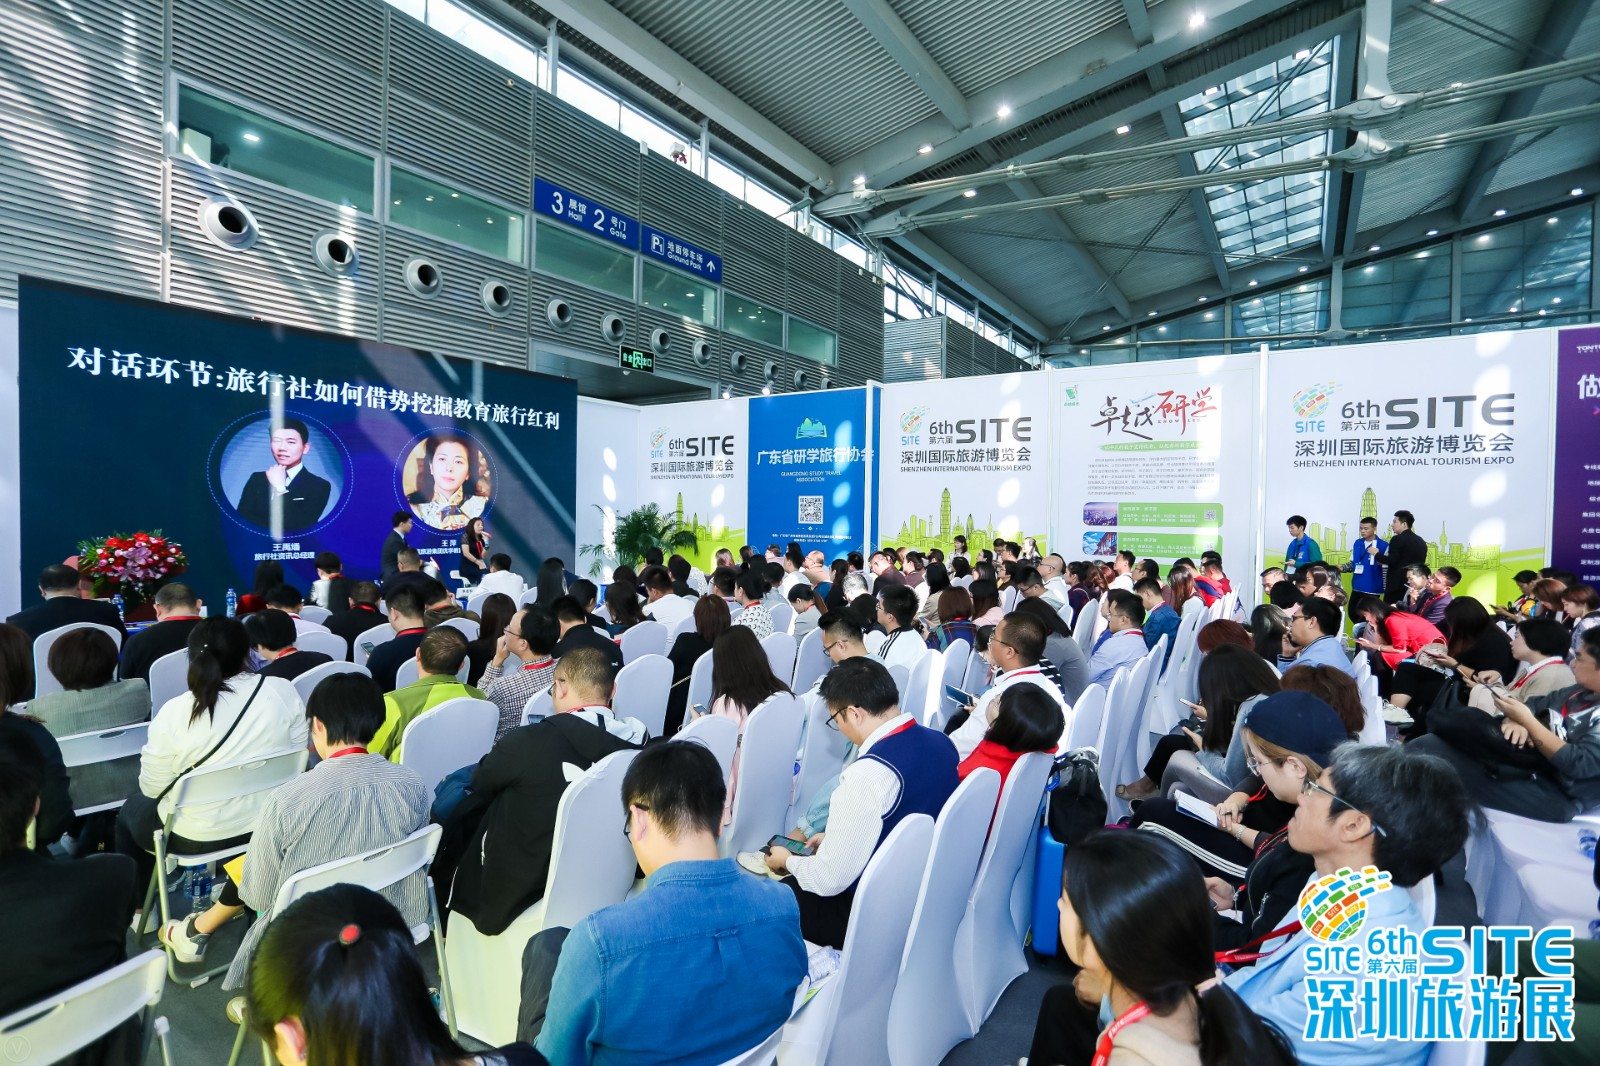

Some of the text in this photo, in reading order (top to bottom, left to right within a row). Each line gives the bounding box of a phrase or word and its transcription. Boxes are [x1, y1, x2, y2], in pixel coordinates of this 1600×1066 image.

[552, 191, 626, 231] 3 展馆 2 号门
[568, 211, 626, 240] Hall Gate
[667, 241, 703, 264] 地面停车场
[667, 251, 702, 271] Ground Park
[1341, 393, 1515, 430] 6th SITE
[929, 416, 1032, 444] 6th SITE
[1295, 420, 1326, 433] SITE
[1340, 419, 1381, 431] 第六届
[668, 435, 734, 457] 6th SITE
[901, 436, 920, 445] SITE
[929, 436, 953, 445] 第六届
[1295, 433, 1515, 457] 深圳国际旅游博览会
[901, 446, 1031, 464] 深圳国际旅游博览会
[1293, 456, 1515, 468] SHENZHEN INTERNATIONAL TOURISM EXPO
[651, 459, 734, 473] 深圳国际旅游博览会
